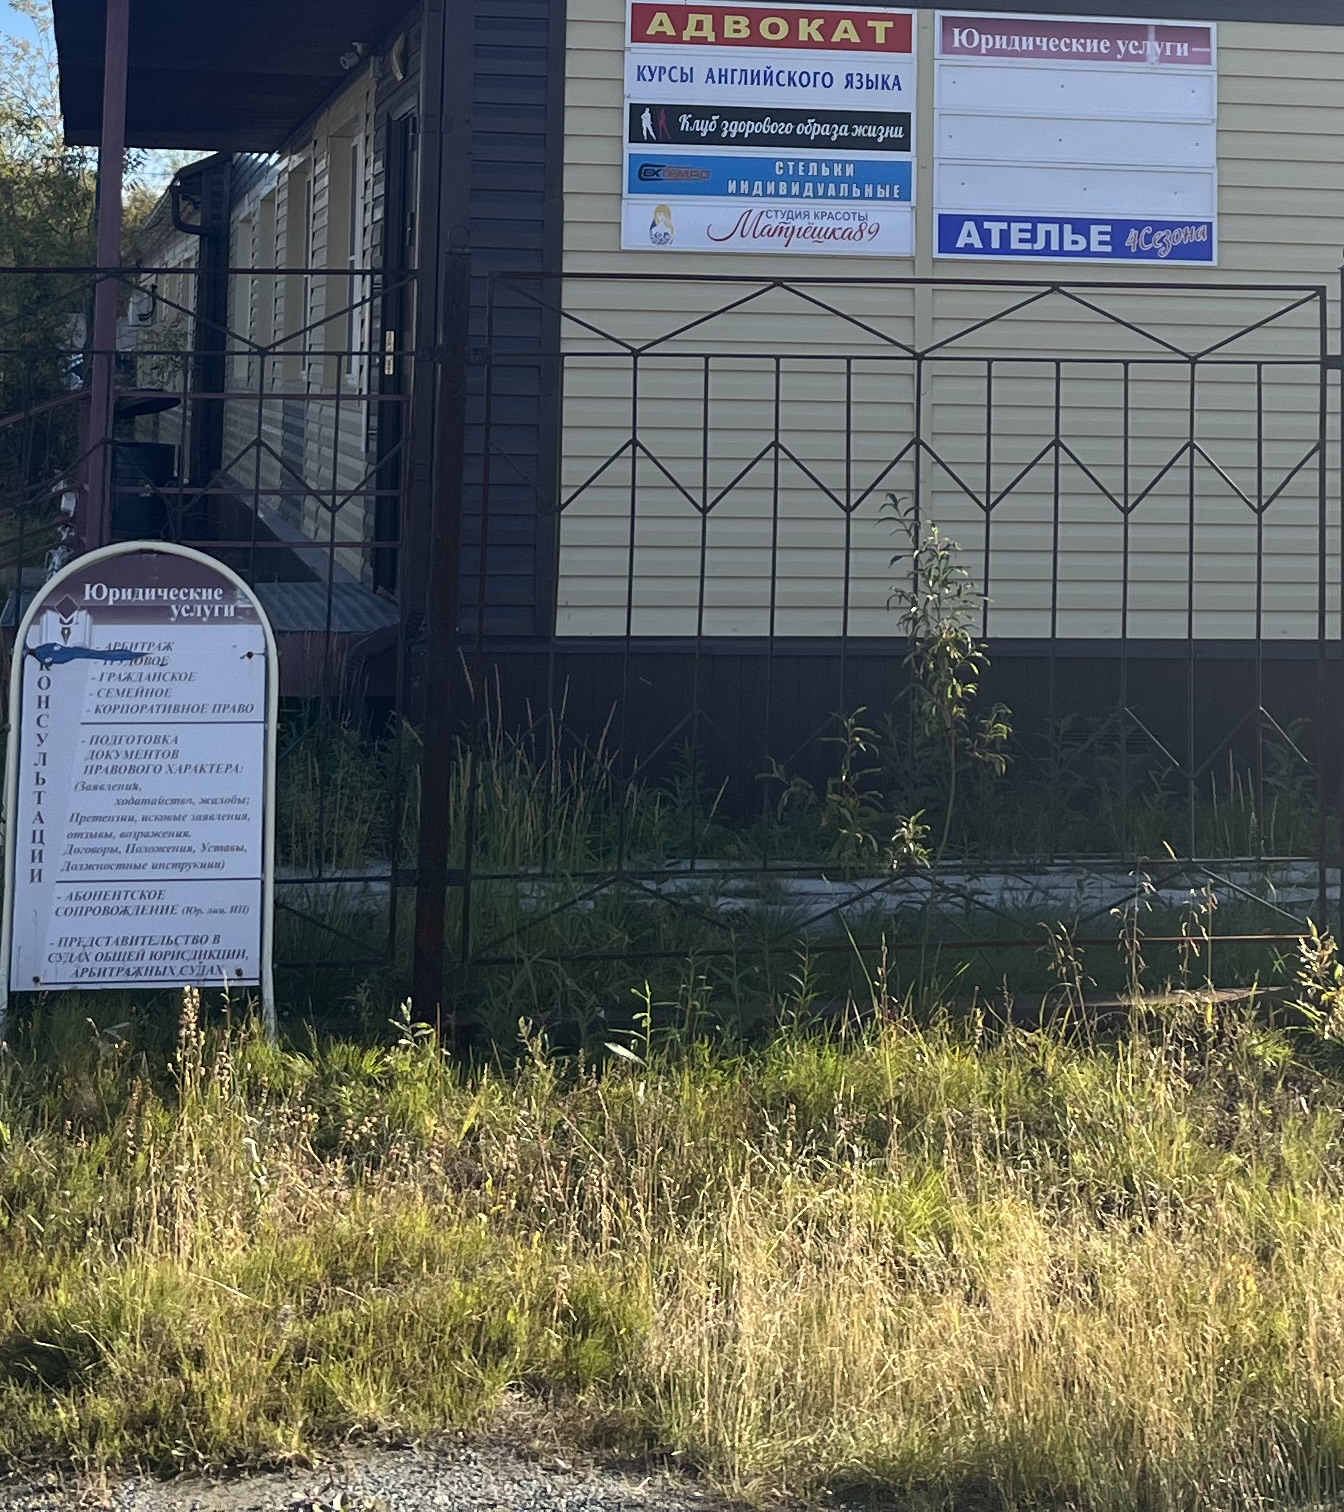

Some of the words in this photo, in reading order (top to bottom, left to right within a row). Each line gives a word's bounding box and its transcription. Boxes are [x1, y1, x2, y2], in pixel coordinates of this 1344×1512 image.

[646, 12, 894, 44] АДВОКАТ
[952, 28, 1110, 53] Юридические
[1116, 39, 1188, 59] услуги
[636, 65, 694, 83] КУРСЫ
[705, 66, 834, 88] АНГЛИЙСКОГО
[844, 72, 902, 90] ЯЗЫКА
[679, 114, 719, 136] Клуб
[721, 117, 794, 138] здорового
[796, 119, 849, 140] образа
[851, 124, 904, 142] жизни
[775, 161, 854, 177] СТЕЛЬКИ
[728, 179, 900, 199] ИНДИВИДУАЛЬНЫЕ
[766, 209, 809, 221] СТУДИЯ
[814, 211, 868, 221] КРАСОТЫ
[956, 220, 1112, 252] АТЕЛЬЕ
[84, 583, 223, 605] Юридические
[170, 603, 235, 621] услуги
[106, 642, 175, 651] АРБИТРАЖ
[99, 672, 197, 683] ГРАЖДАНСКОЕ
[97, 687, 172, 698] СЕМЕЙНОЕ
[94, 704, 207, 714] КОРПОРАТИВНОЕ
[212, 703, 254, 713] ПРАВО
[89, 735, 178, 746] ПОДГОТОВКА
[84, 749, 179, 760] ДОКУМЕНТОВ
[84, 764, 163, 775] ПРАВОВОГО
[165, 763, 244, 774] ХАРАКТЕРА:
[69, 813, 137, 825] Претензии,
[141, 814, 188, 822] исковые
[191, 813, 251, 822] заявления,
[60, 860, 150, 873] Должностные
[151, 860, 225, 872] инструкции)
[65, 890, 166, 901] АБОНЕНТСКОЕ
[55, 905, 179, 917] СОПРОВОЖДЕНИЕ
[58, 935, 209, 948] ПРЕДСТАВИТЕЛЬСТВО
[212, 935, 221, 944] В
[48, 952, 90, 964] СУДАХ
[94, 950, 146, 963] ОБЩЕЙ
[149, 948, 249, 962] ЮРИСДИКЦИИ,
[71, 965, 176, 978] АРБИТРАЖНЫХ
[179, 965, 224, 976] СУДАХ
